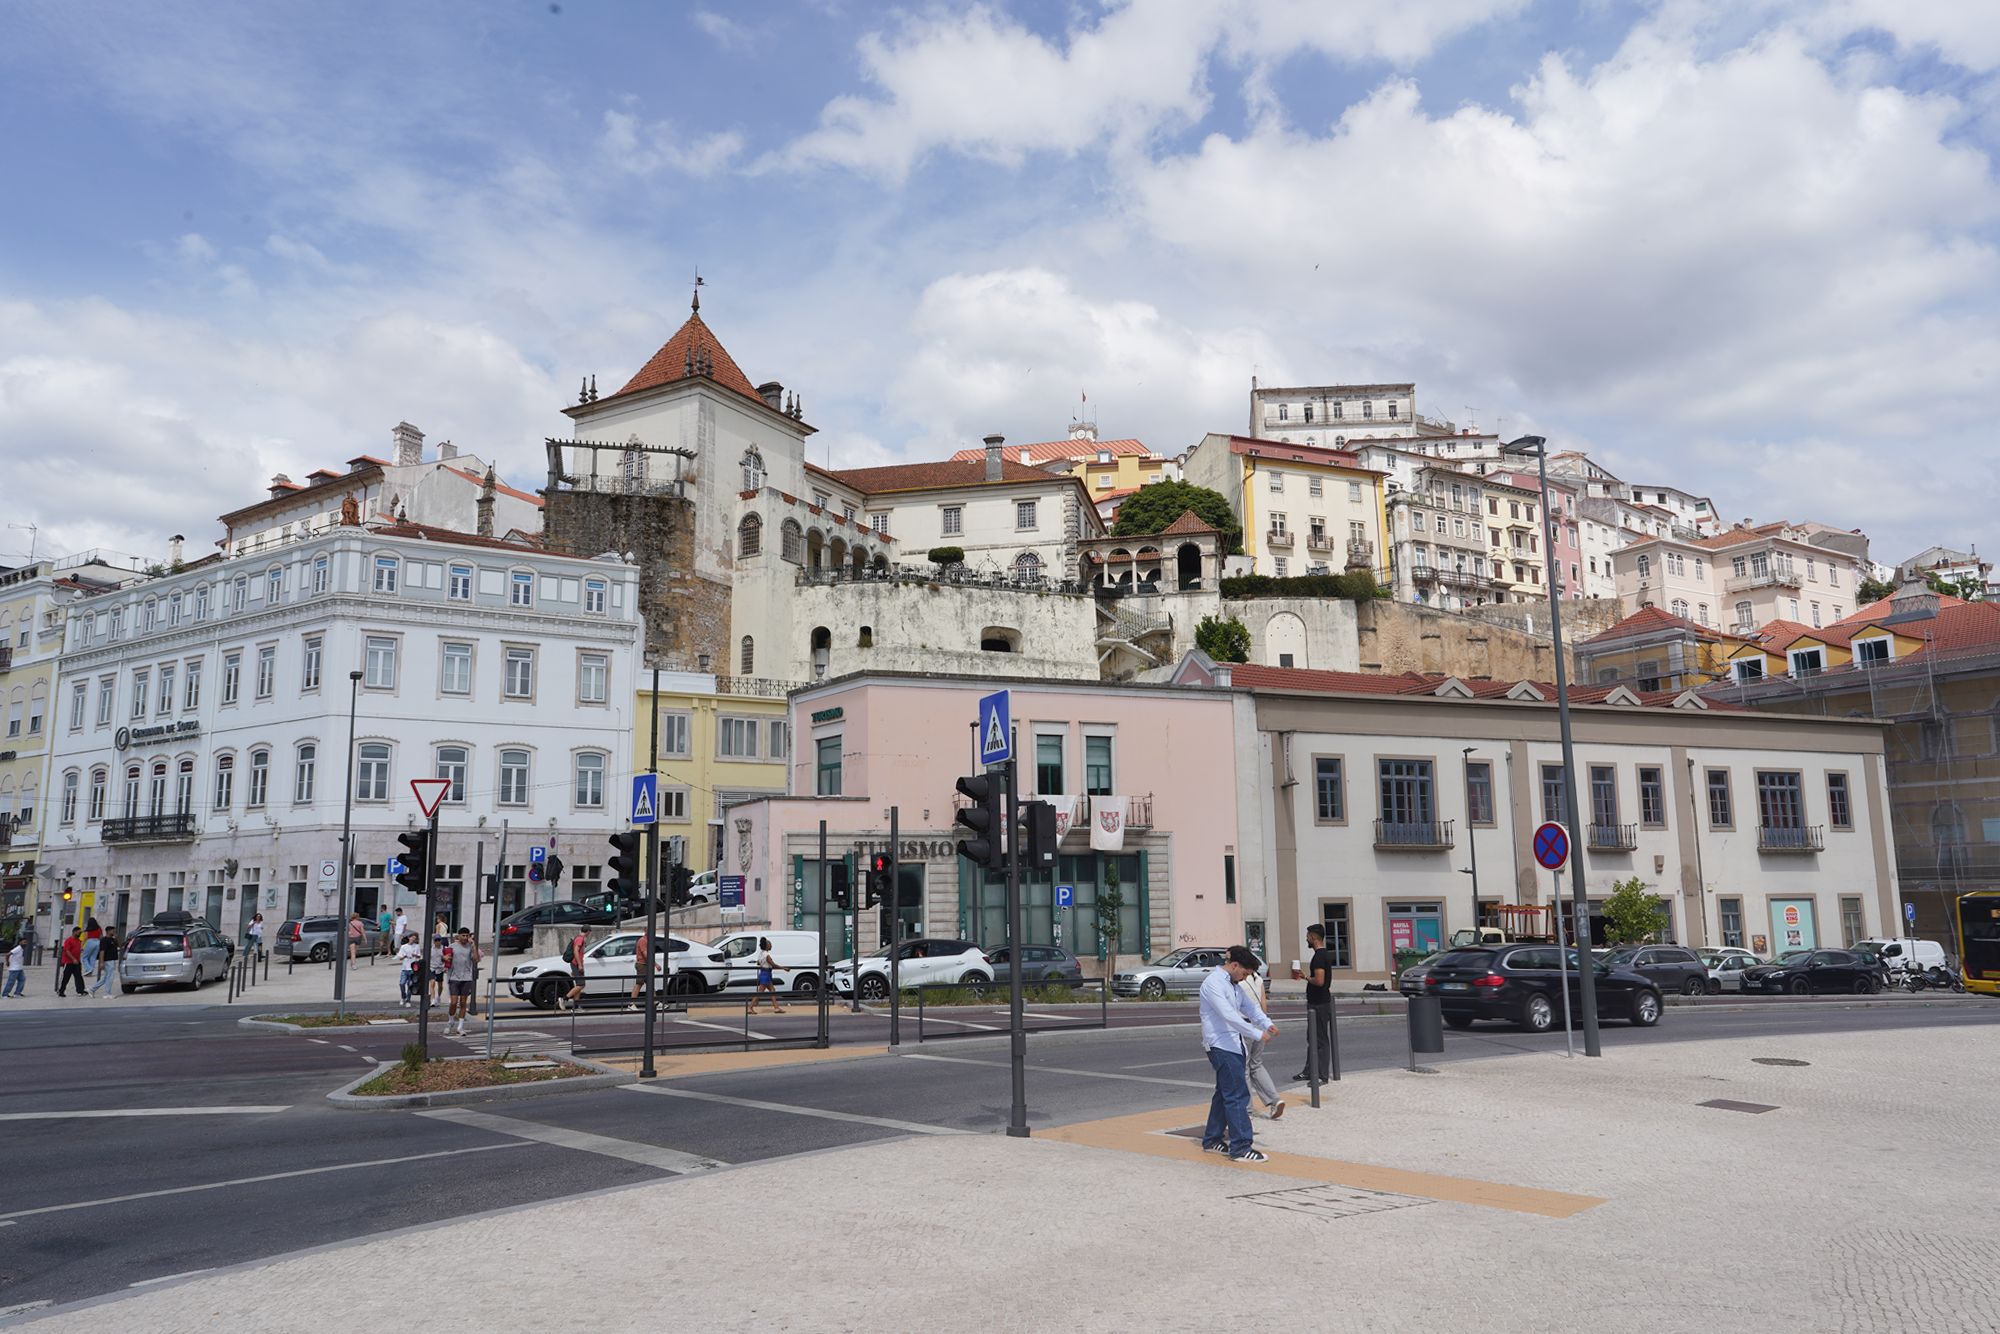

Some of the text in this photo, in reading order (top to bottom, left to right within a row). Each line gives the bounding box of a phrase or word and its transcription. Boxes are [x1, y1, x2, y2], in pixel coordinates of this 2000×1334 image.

[811, 706, 844, 723] TURISMO
[533, 848, 543, 861] P
[391, 859, 401, 873] P
[1059, 888, 1070, 904] P
[1908, 904, 1913, 918] P
